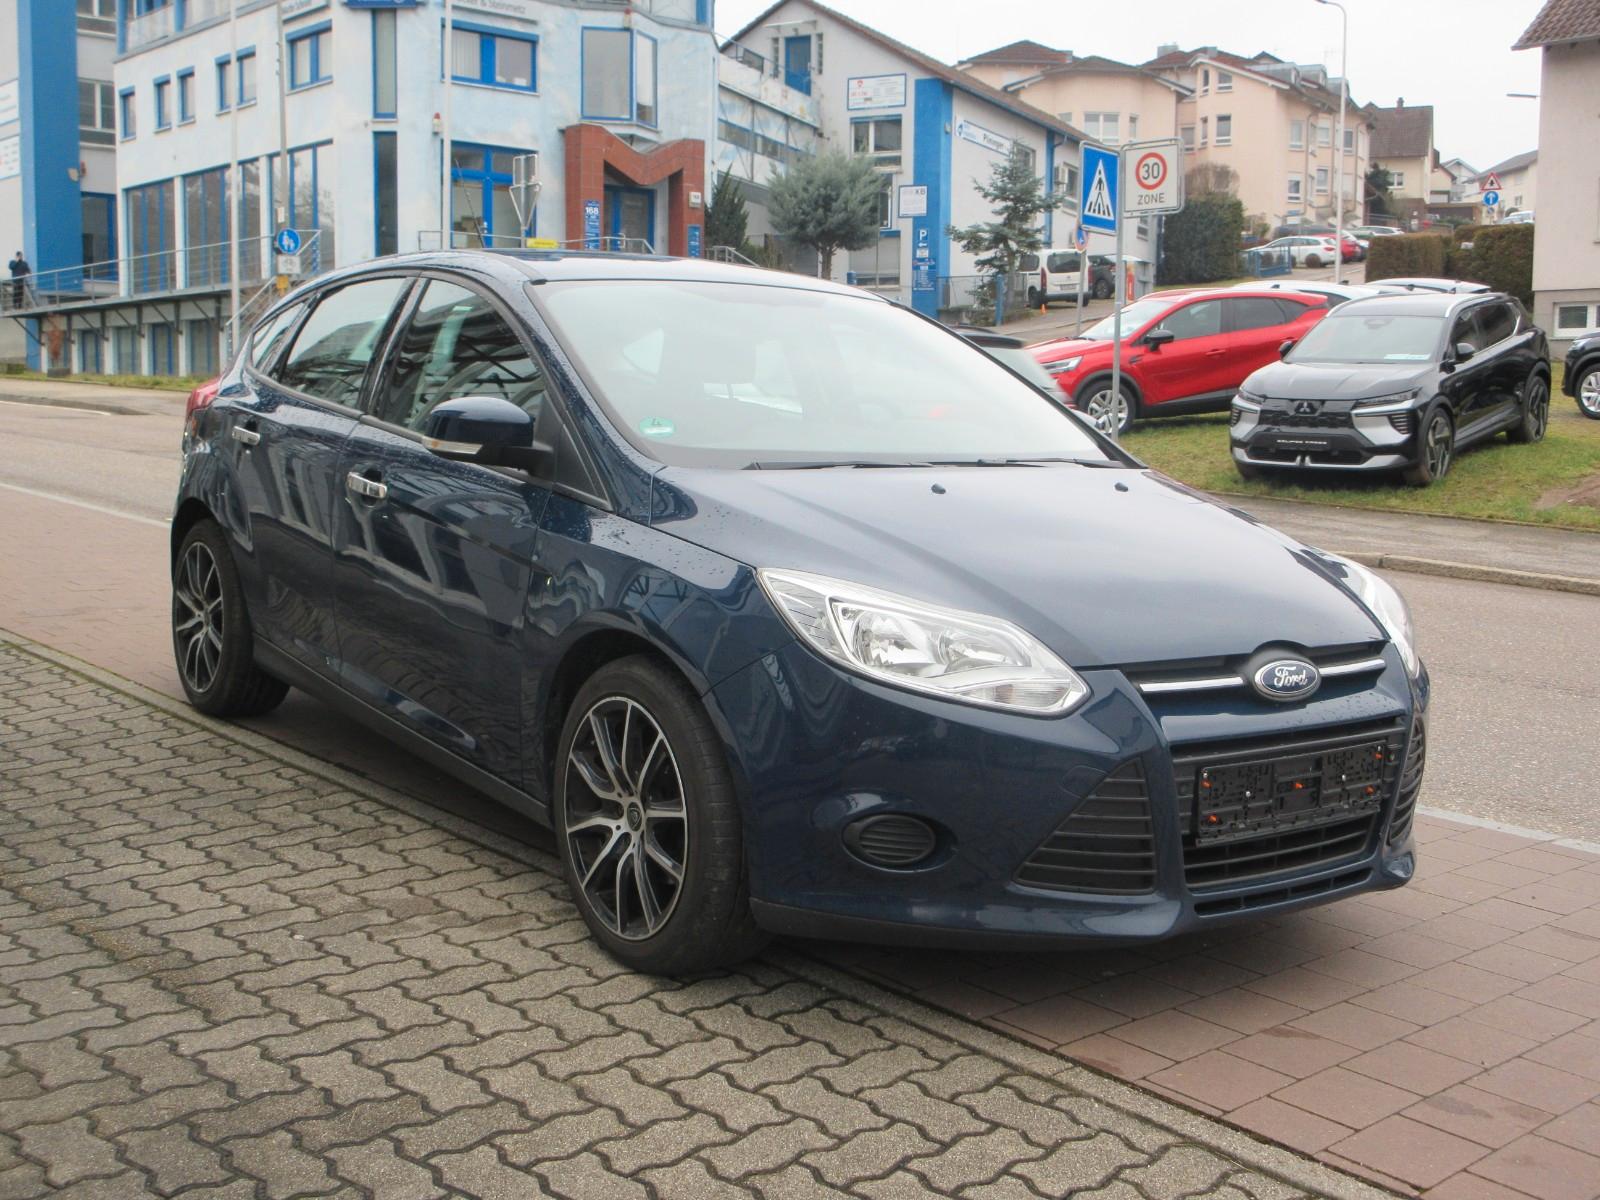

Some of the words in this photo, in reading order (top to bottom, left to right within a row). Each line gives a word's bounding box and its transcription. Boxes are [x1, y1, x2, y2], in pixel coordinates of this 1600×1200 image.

[1142, 162, 1160, 180] 30
[1137, 192, 1166, 206] ZONE
[585, 206, 599, 215] 168
[920, 230, 927, 241] P
[1274, 666, 1308, 688] Ford
